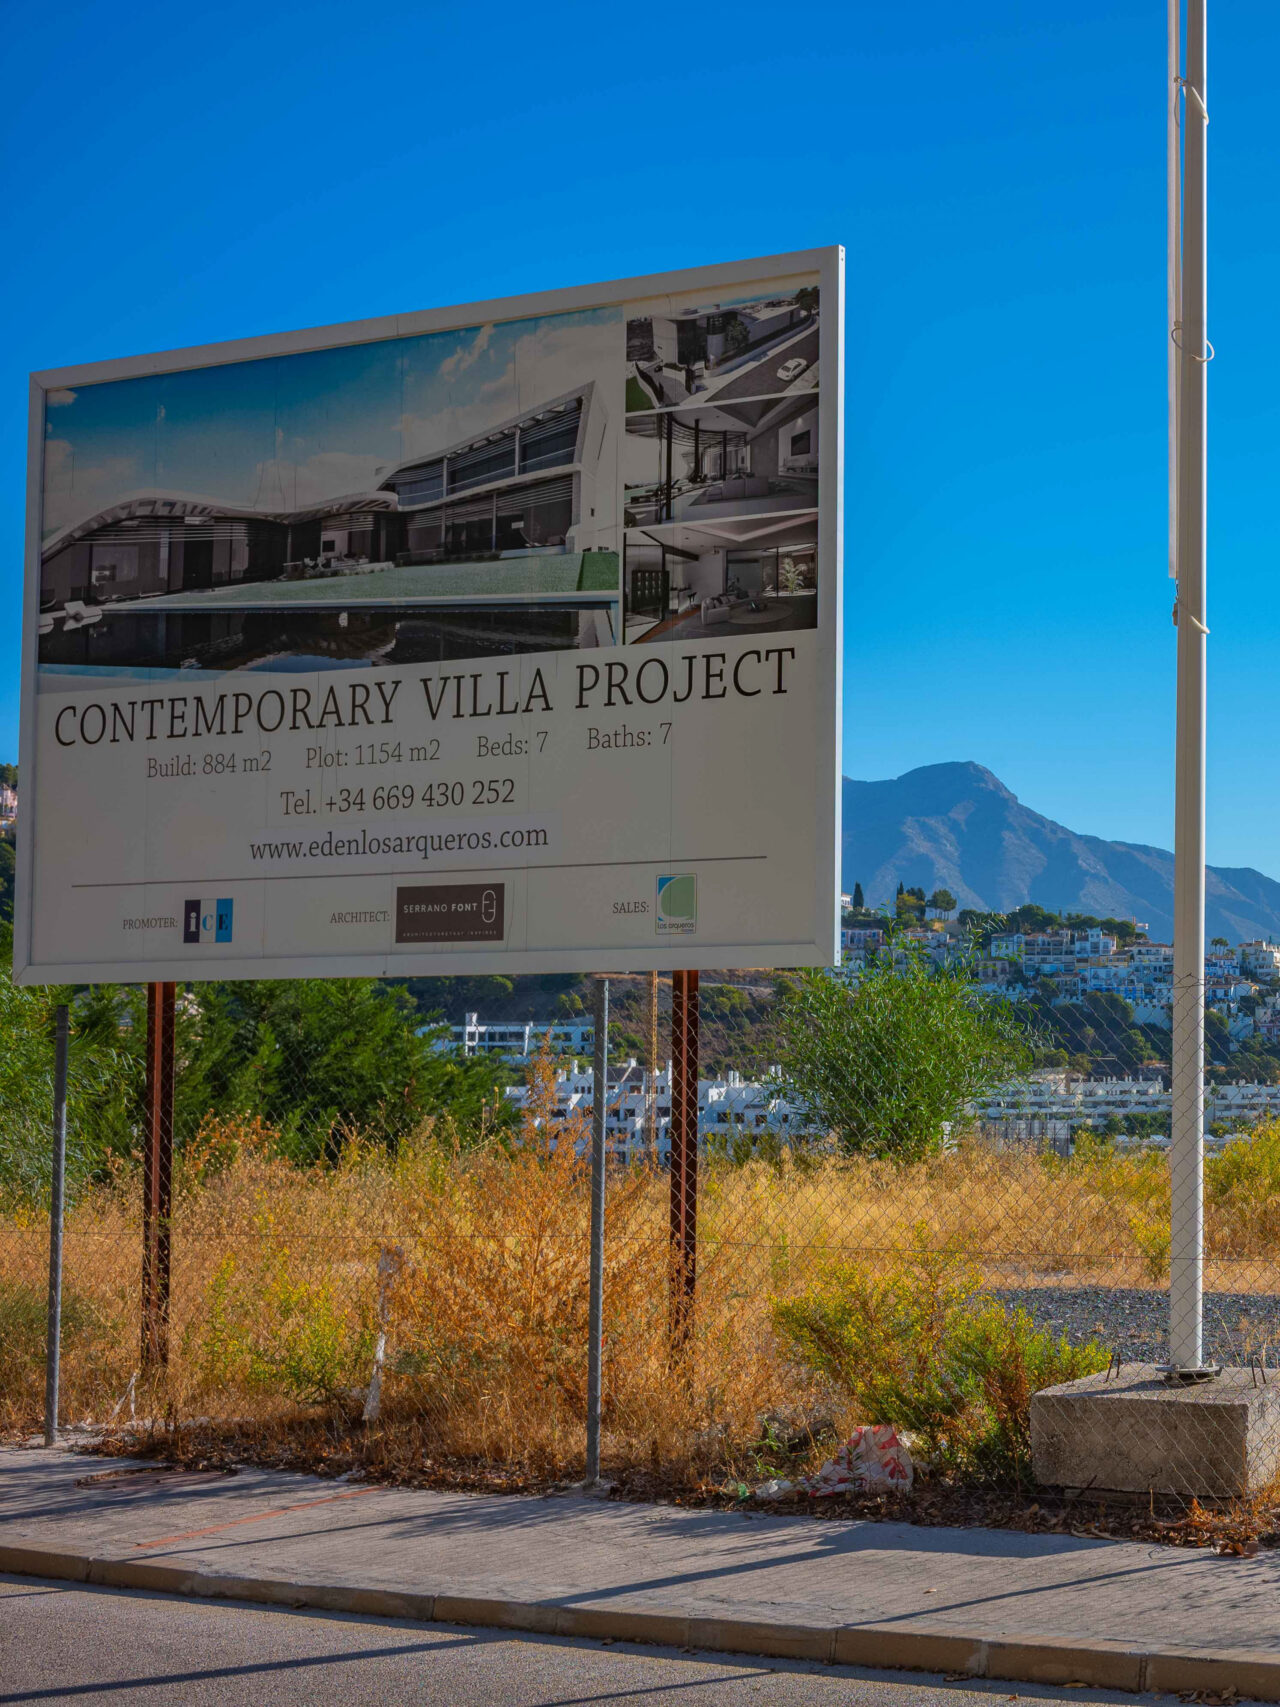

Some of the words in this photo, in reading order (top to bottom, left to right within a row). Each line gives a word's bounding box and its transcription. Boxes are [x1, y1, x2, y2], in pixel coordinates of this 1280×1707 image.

[54, 680, 402, 746] CONTEMPORARY
[420, 667, 553, 721] VILLA
[575, 647, 796, 709] PROJECT
[146, 754, 197, 778] Build:
[203, 753, 236, 775] 884
[243, 750, 272, 773] m2
[305, 746, 349, 769] Plot:
[355, 741, 402, 766] 1154
[409, 739, 441, 762] m2
[476, 732, 529, 758] Beds:
[536, 731, 549, 753] 7
[586, 723, 652, 750] Baths:
[659, 722, 673, 745] 7
[280, 789, 317, 815] Tel.
[325, 787, 366, 812] +34
[372, 784, 415, 810] 669
[421, 781, 465, 807] 430
[471, 778, 516, 805] 252
[249, 826, 549, 860] www.edenlosarqueros.com
[329, 910, 390, 924] ARCHITECT:
[403, 903, 448, 914] SERRANO
[450, 902, 478, 913] FONT
[612, 901, 650, 914] SALES:
[122, 916, 178, 931] PROMOTER:
